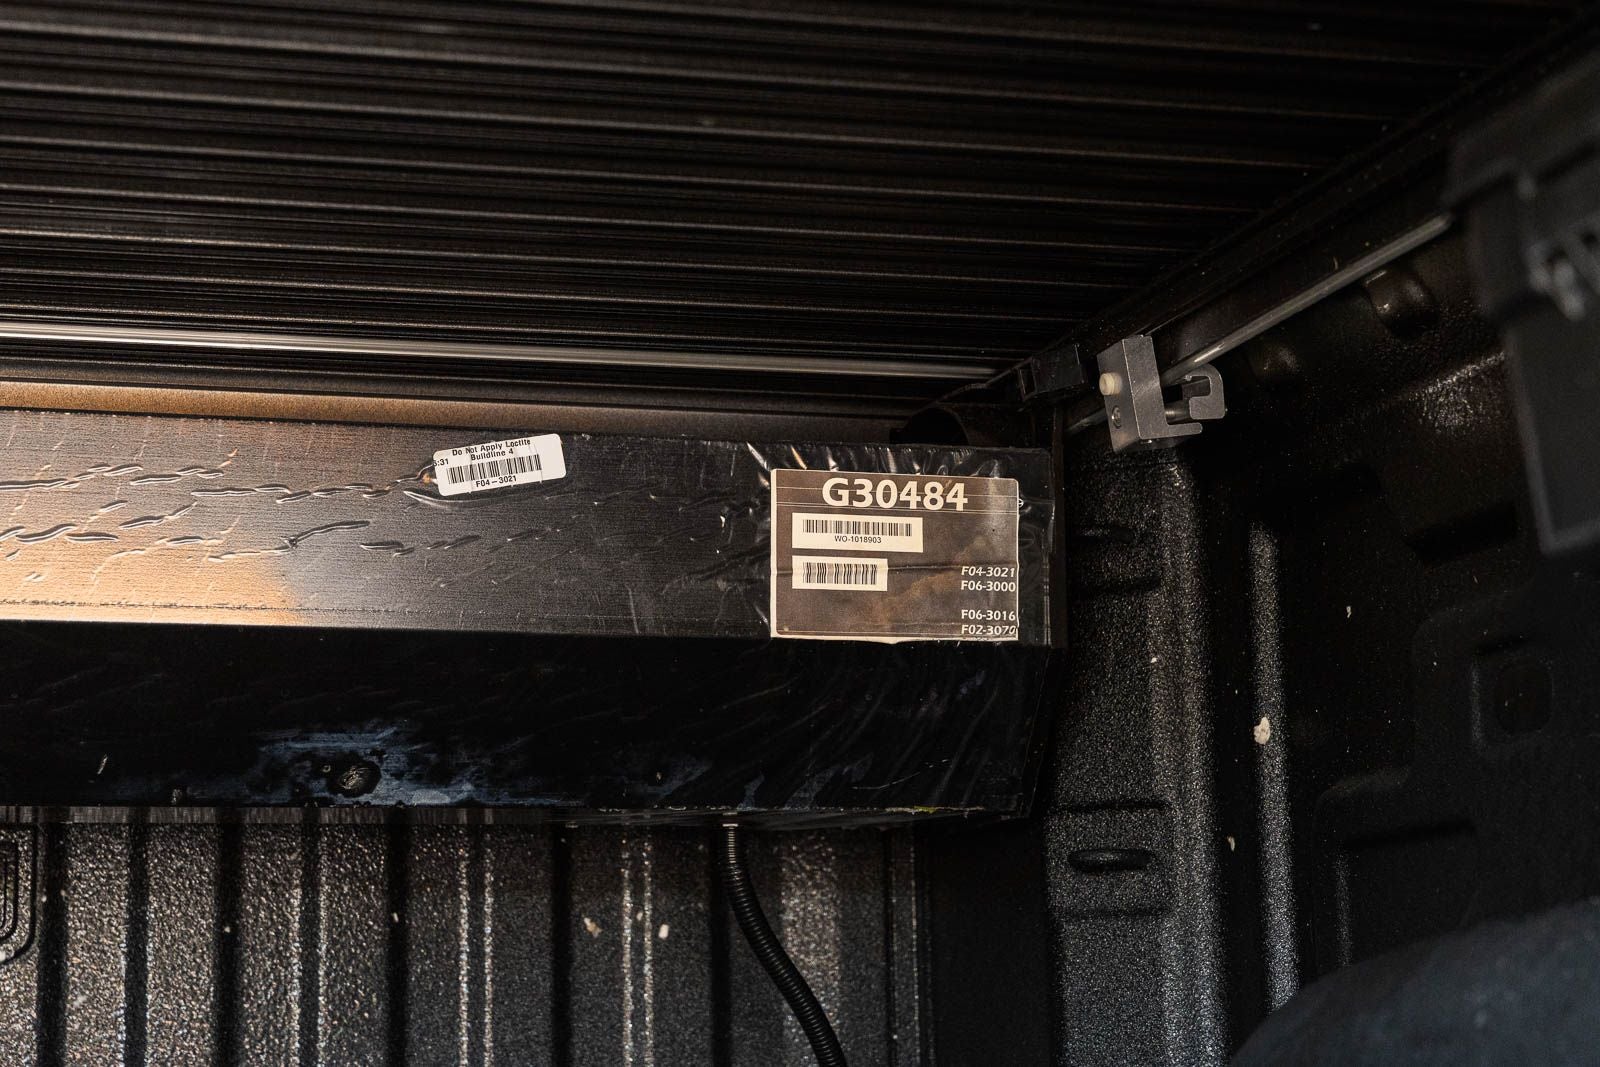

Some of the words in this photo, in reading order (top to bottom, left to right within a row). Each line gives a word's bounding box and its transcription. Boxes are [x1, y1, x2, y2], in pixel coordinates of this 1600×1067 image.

[452, 449, 462, 457] Do
[465, 446, 477, 454] Not
[480, 442, 503, 453] Apply
[505, 439, 531, 448] Loctite
[470, 449, 506, 461] Buildline
[822, 478, 968, 511] G30484
[834, 535, 882, 544] WO-1018903
[961, 566, 1015, 578] F04-3021
[960, 580, 1016, 593] F06-3000
[961, 609, 1016, 622] F06-3016
[961, 624, 1017, 635] F02-3070
